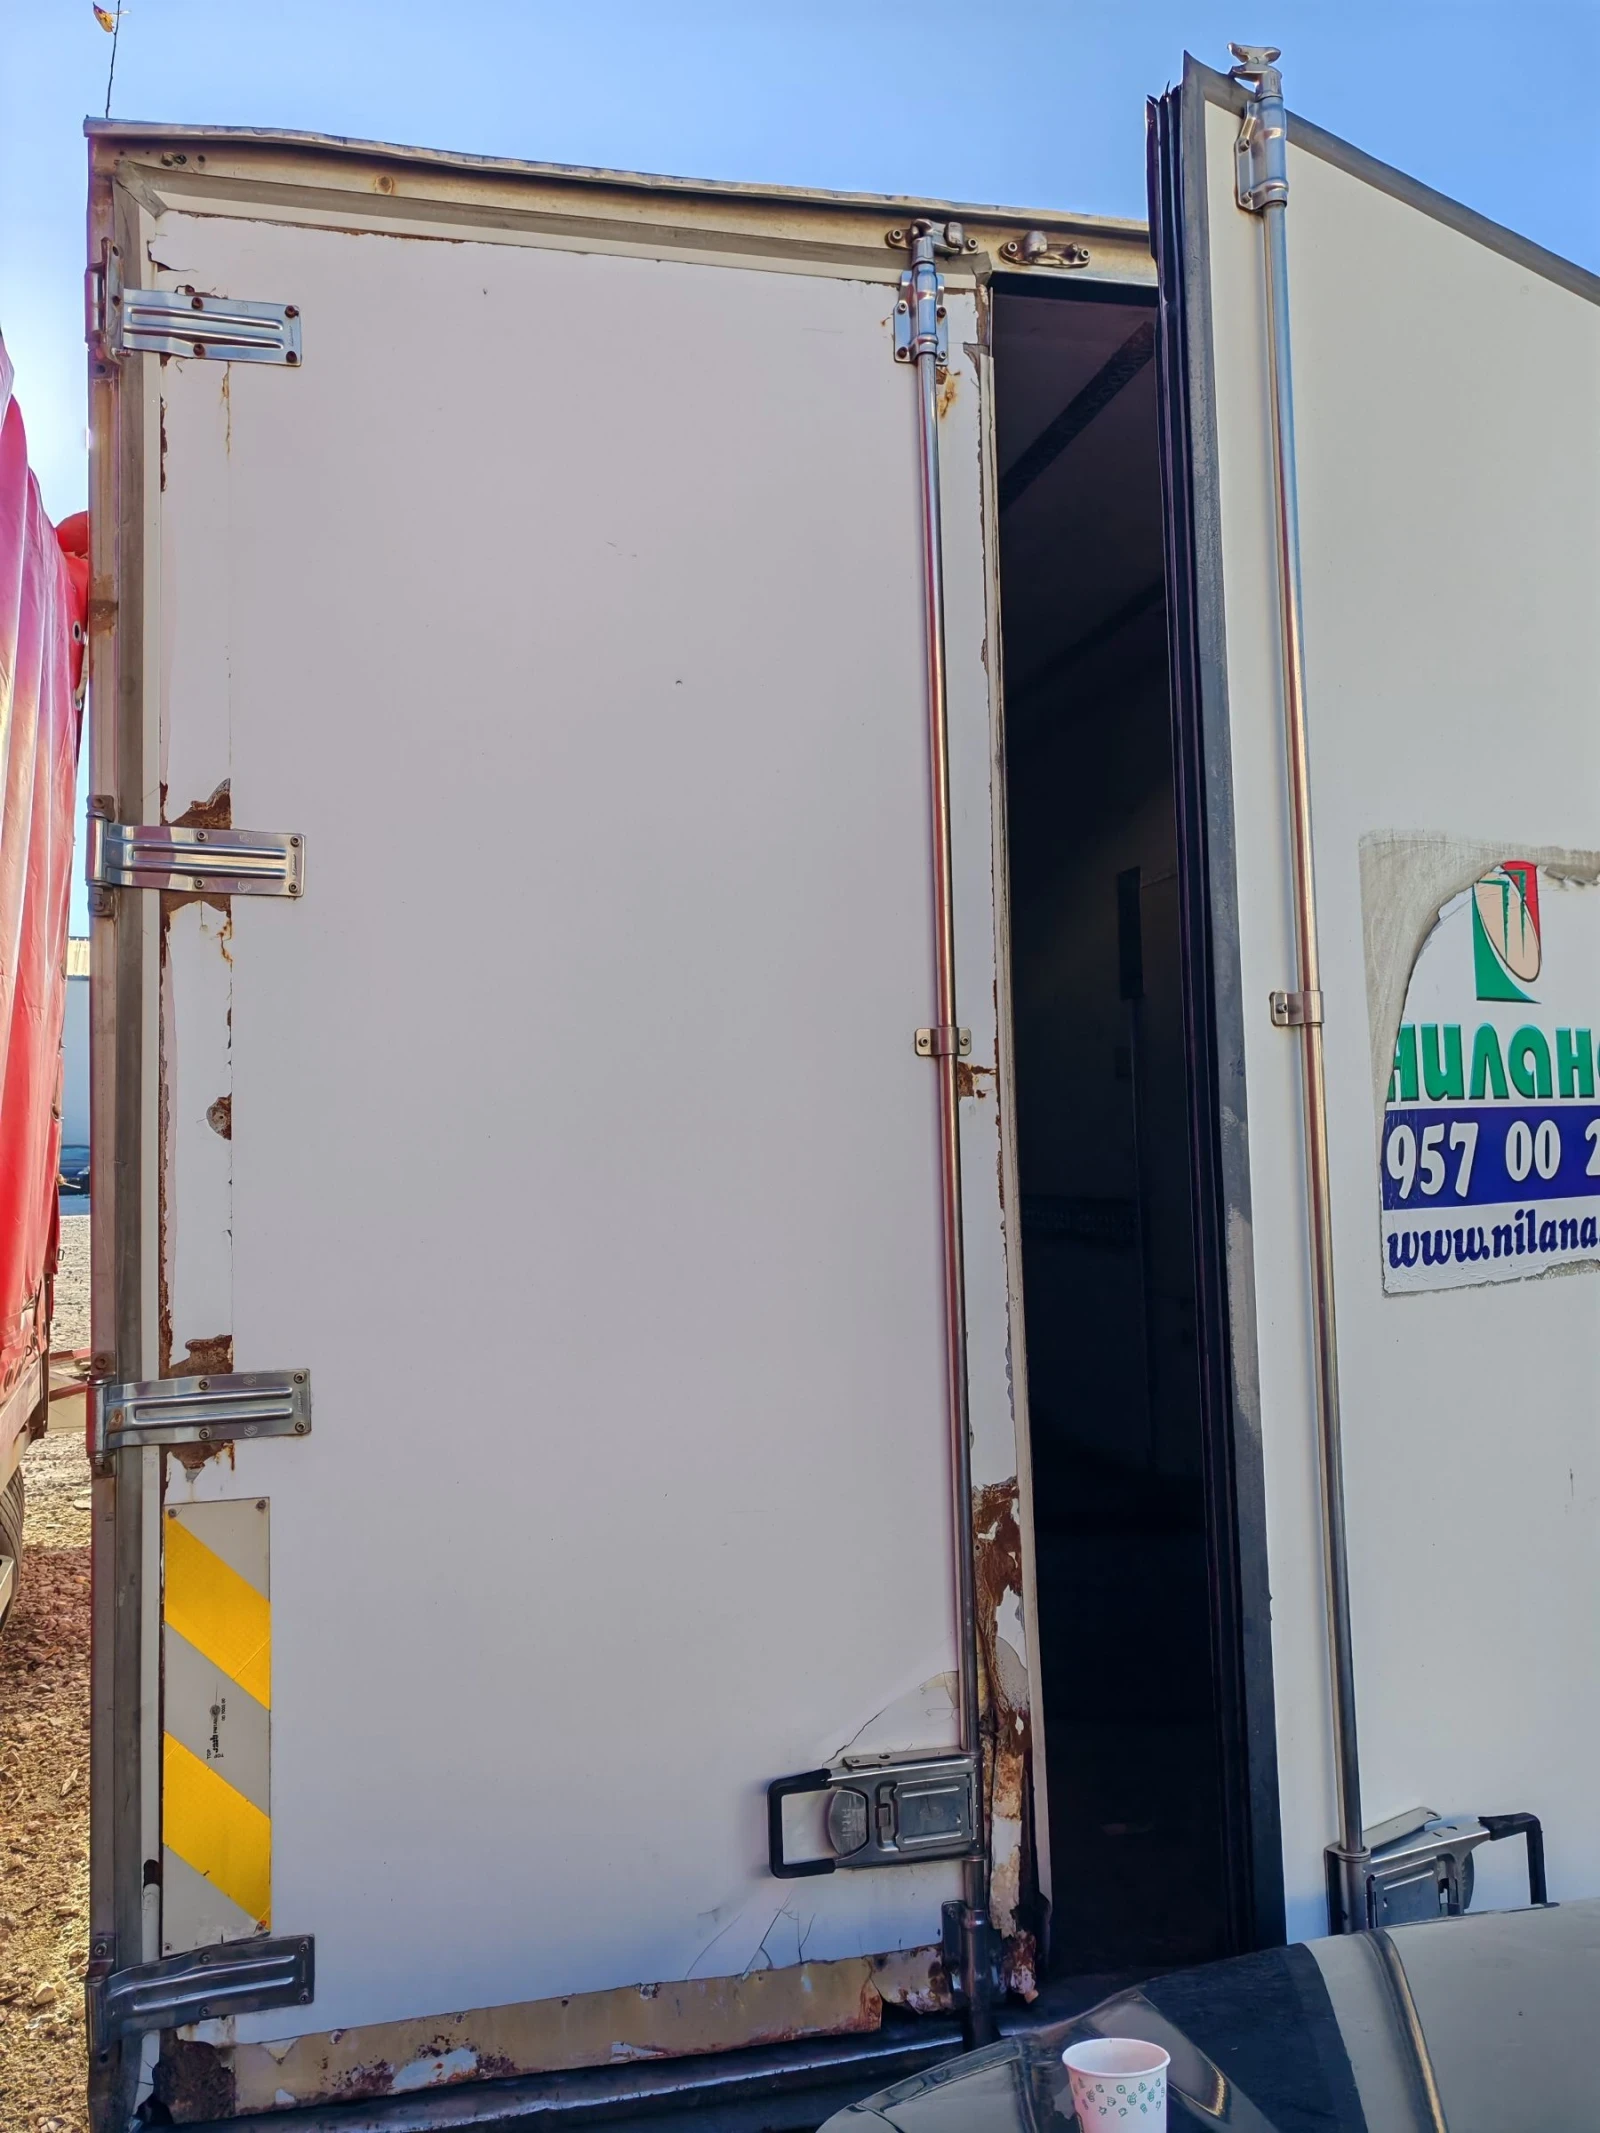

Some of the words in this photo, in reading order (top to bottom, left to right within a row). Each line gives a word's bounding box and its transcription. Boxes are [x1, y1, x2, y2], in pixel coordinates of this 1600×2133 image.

[1386, 1121, 1479, 1200] 957
[1505, 1120, 1561, 1182] 00
[1387, 1209, 1600, 1268] www.nilana
